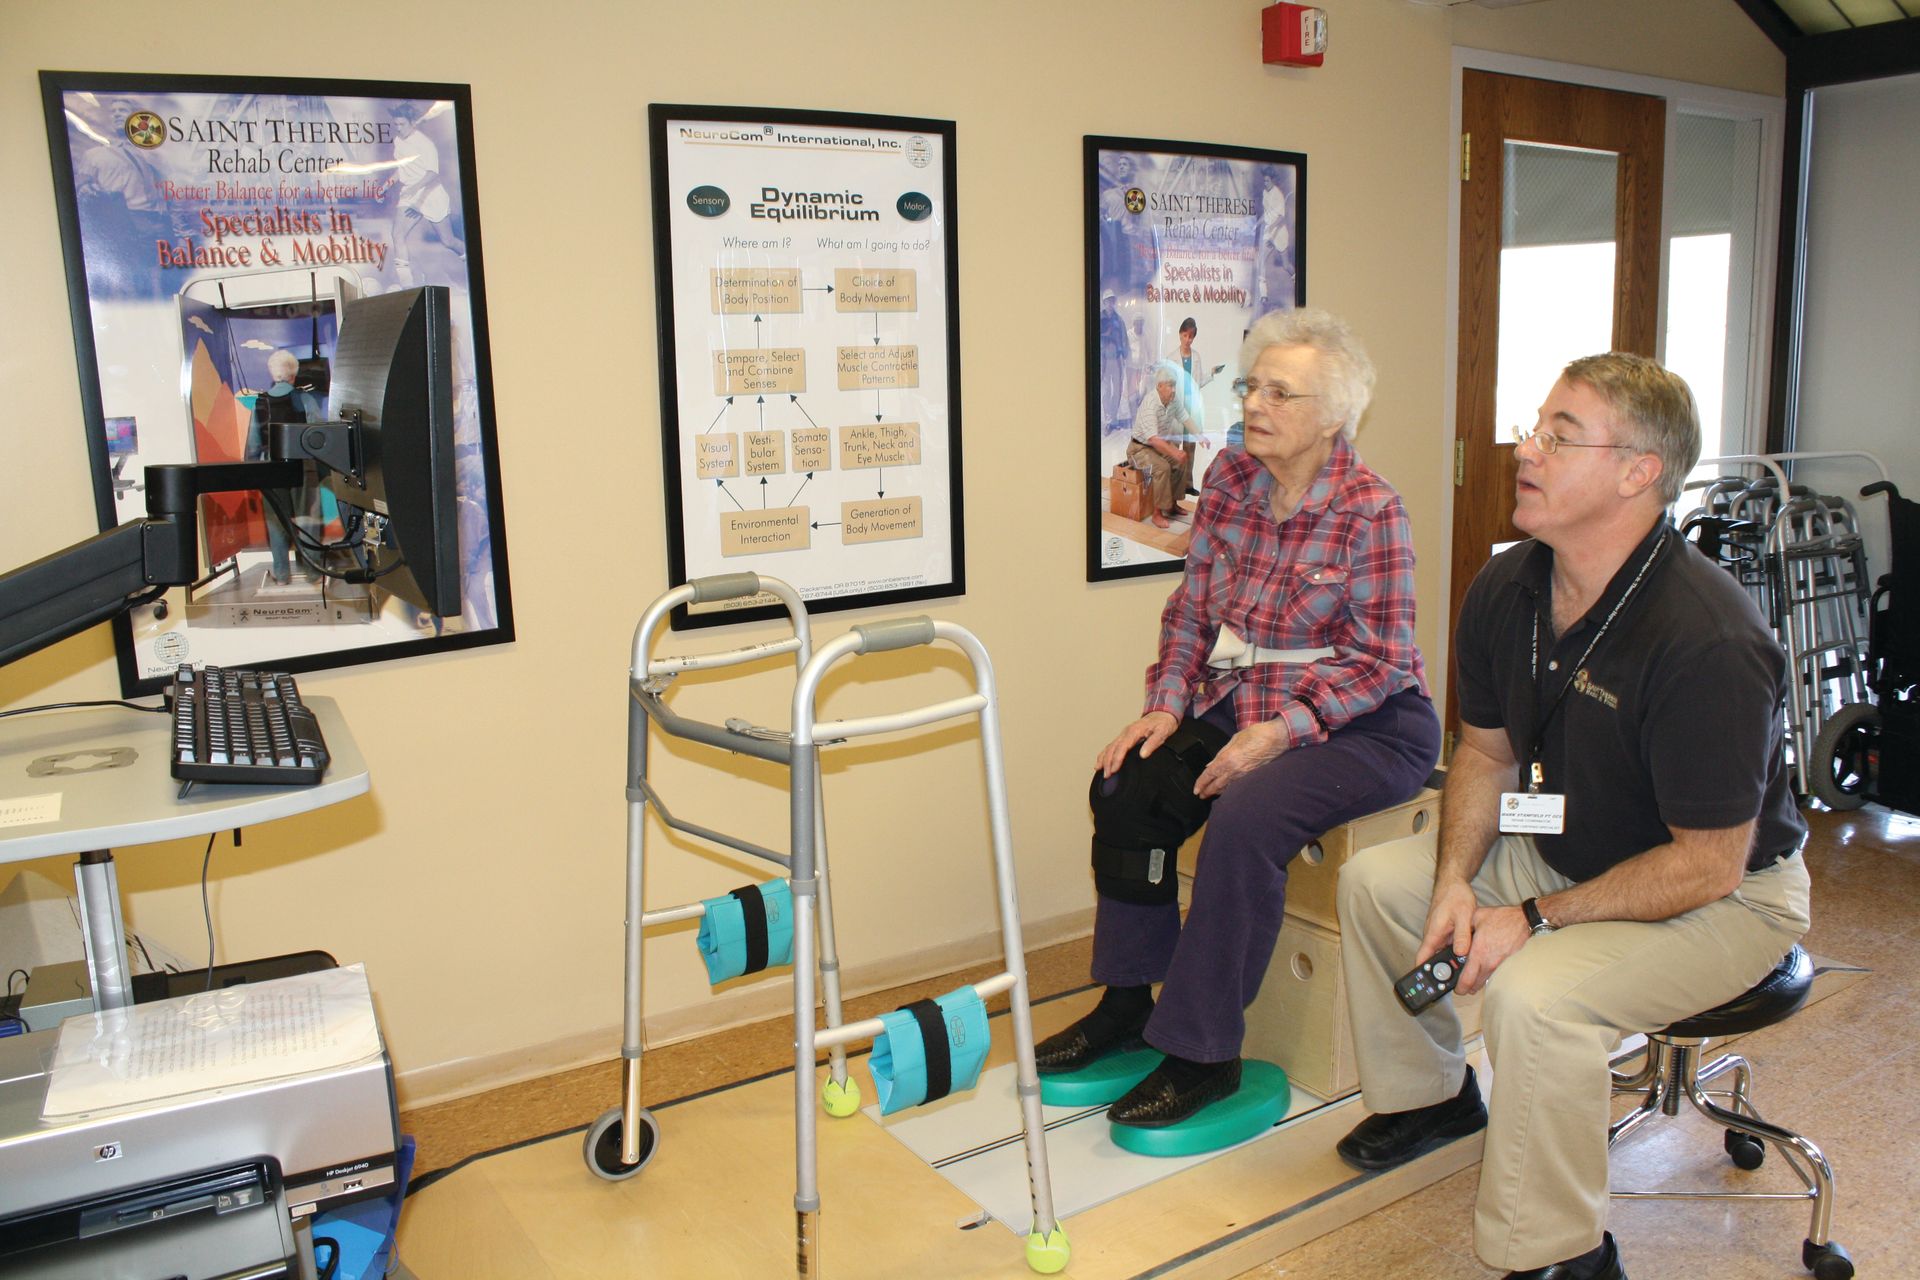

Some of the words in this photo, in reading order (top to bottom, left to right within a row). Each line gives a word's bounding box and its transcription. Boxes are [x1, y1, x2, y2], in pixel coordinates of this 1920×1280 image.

[169, 116, 258, 144] SAINT
[265, 118, 394, 145] THERESE
[777, 132, 875, 149] International,
[877, 137, 902, 149] Inc.
[208, 147, 270, 175] Rehab
[278, 149, 344, 174] Center
[216, 180, 273, 200] Balance
[277, 180, 300, 200] for
[304, 186, 312, 199] a
[316, 180, 358, 199] better
[761, 186, 863, 207] Dynamic
[692, 194, 725, 207] Sensory
[904, 202, 926, 211] Motor
[1150, 192, 1193, 211] SAINT
[1195, 195, 1257, 216] THERESE
[750, 203, 880, 224] Equilibrium
[200, 204, 323, 245] Specialists
[329, 206, 354, 233] in
[1164, 216, 1199, 240] Rehab
[1203, 219, 1240, 241] Center
[722, 236, 758, 249] Where
[761, 239, 779, 248] am
[782, 236, 792, 248] I?
[816, 237, 844, 250] What
[846, 240, 862, 249] am
[871, 240, 898, 253] going
[901, 240, 910, 250] to
[912, 240, 930, 251] do?
[156, 237, 251, 269] Balance
[259, 237, 282, 266] &
[291, 234, 388, 272] Mobility
[1164, 262, 1221, 285] Specialists
[1222, 264, 1234, 282] in
[715, 277, 784, 288] Determination
[788, 276, 798, 287] of
[851, 276, 883, 287] Choice
[885, 276, 895, 287] of
[724, 295, 749, 305] Body
[751, 294, 789, 304] Position
[839, 293, 863, 305] Body
[864, 293, 910, 303] Movement
[1146, 284, 1191, 304] Balance
[1193, 284, 1202, 303] &
[1203, 284, 1248, 308] Mobility
[771, 352, 800, 363] Select
[840, 349, 868, 361] Select
[868, 349, 886, 360] and
[887, 348, 915, 362] Adjust
[724, 365, 744, 376] and
[747, 365, 793, 376] Combine
[837, 361, 869, 373] Muscle
[870, 361, 918, 372] Contractile
[743, 379, 777, 390] Senses
[862, 374, 896, 385] Patterns
[792, 433, 828, 444] Somato
[850, 429, 878, 440] Ankle,
[880, 427, 908, 440] Thigh,
[749, 435, 775, 446] Vesti-
[843, 441, 870, 453] Trunk,
[873, 440, 895, 450] Neck
[897, 438, 914, 449] and
[700, 442, 731, 454] Visual
[750, 447, 776, 459] bular
[795, 445, 825, 456] Sensa-
[699, 457, 734, 470] System
[802, 458, 820, 468] tion
[857, 454, 873, 465] Eye
[874, 452, 905, 463] Muscle
[746, 460, 780, 473] System
[850, 506, 900, 520] Generation
[902, 504, 912, 515] of
[731, 515, 799, 530] Environmental
[846, 523, 868, 536] Body
[870, 519, 916, 532] Movement
[740, 531, 791, 545] Interaction
[147, 661, 200, 673] Neurom
[101, 1144, 115, 1159] hp
